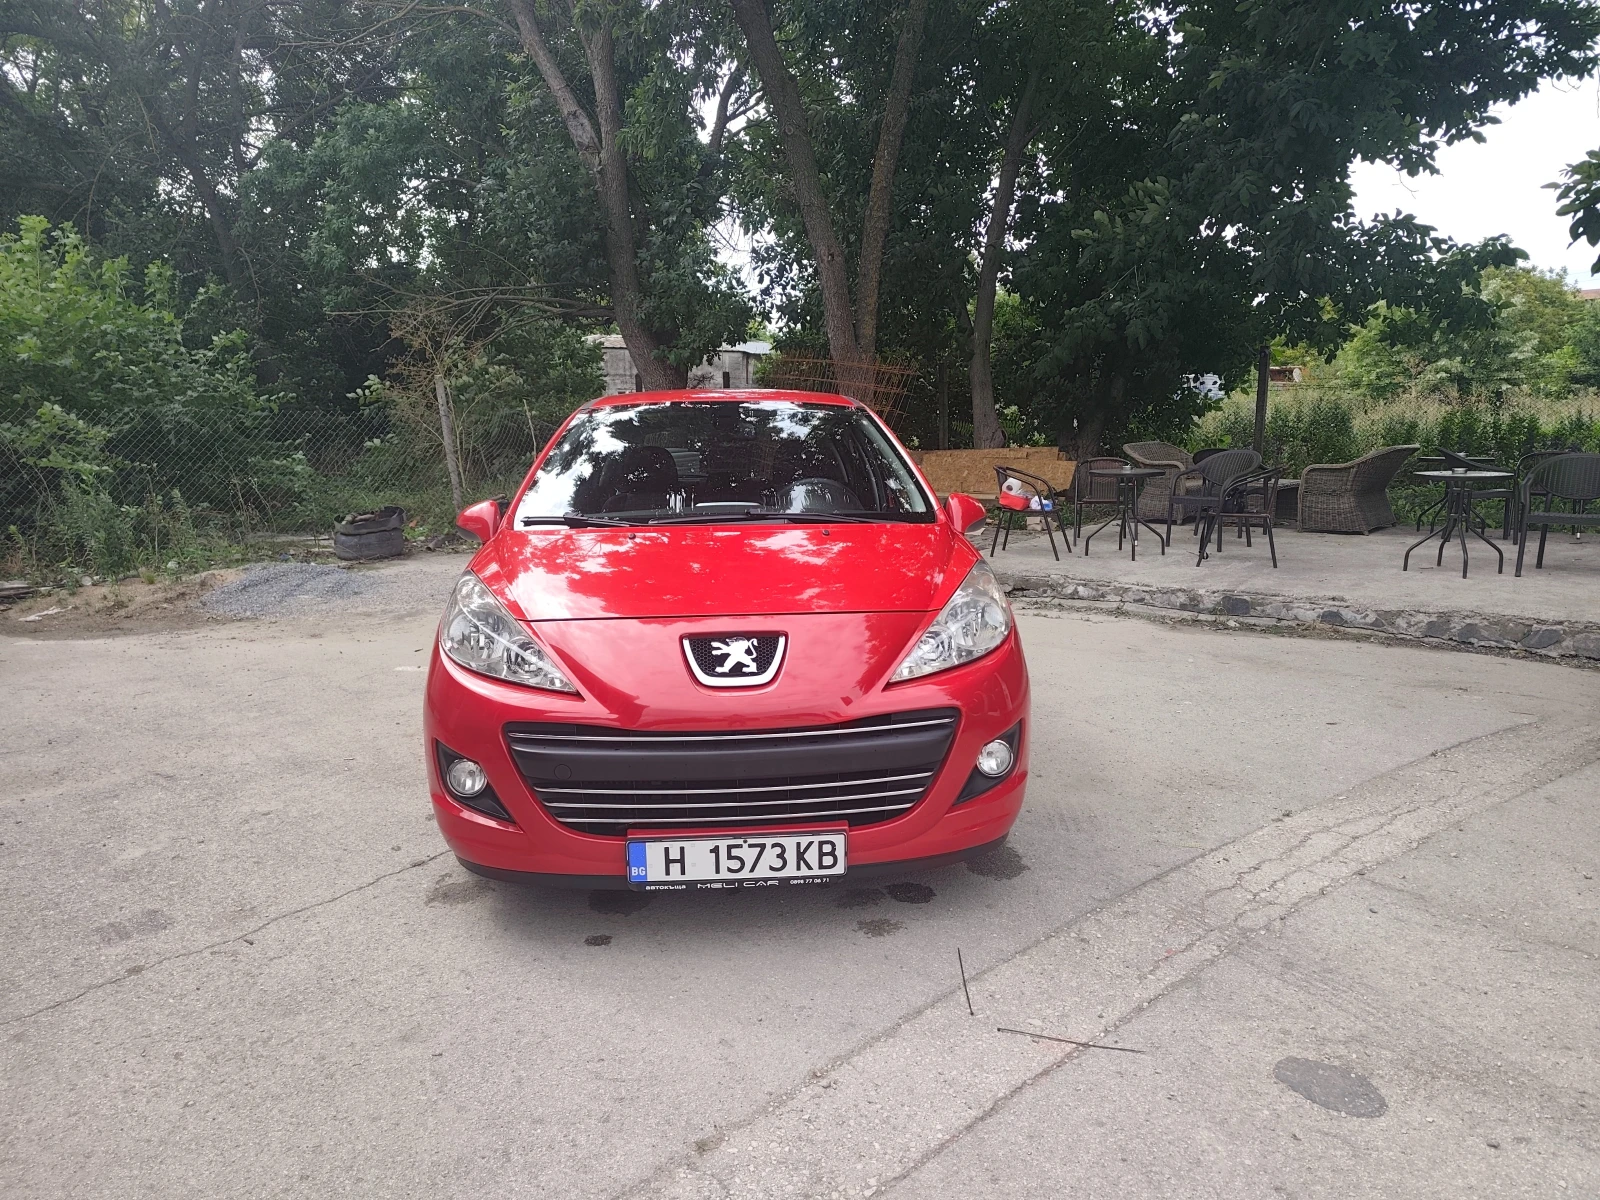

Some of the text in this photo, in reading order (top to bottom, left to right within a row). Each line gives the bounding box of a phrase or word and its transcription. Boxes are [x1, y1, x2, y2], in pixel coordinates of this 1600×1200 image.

[664, 840, 838, 876] H 1573 KB
[631, 867, 646, 876] BG
